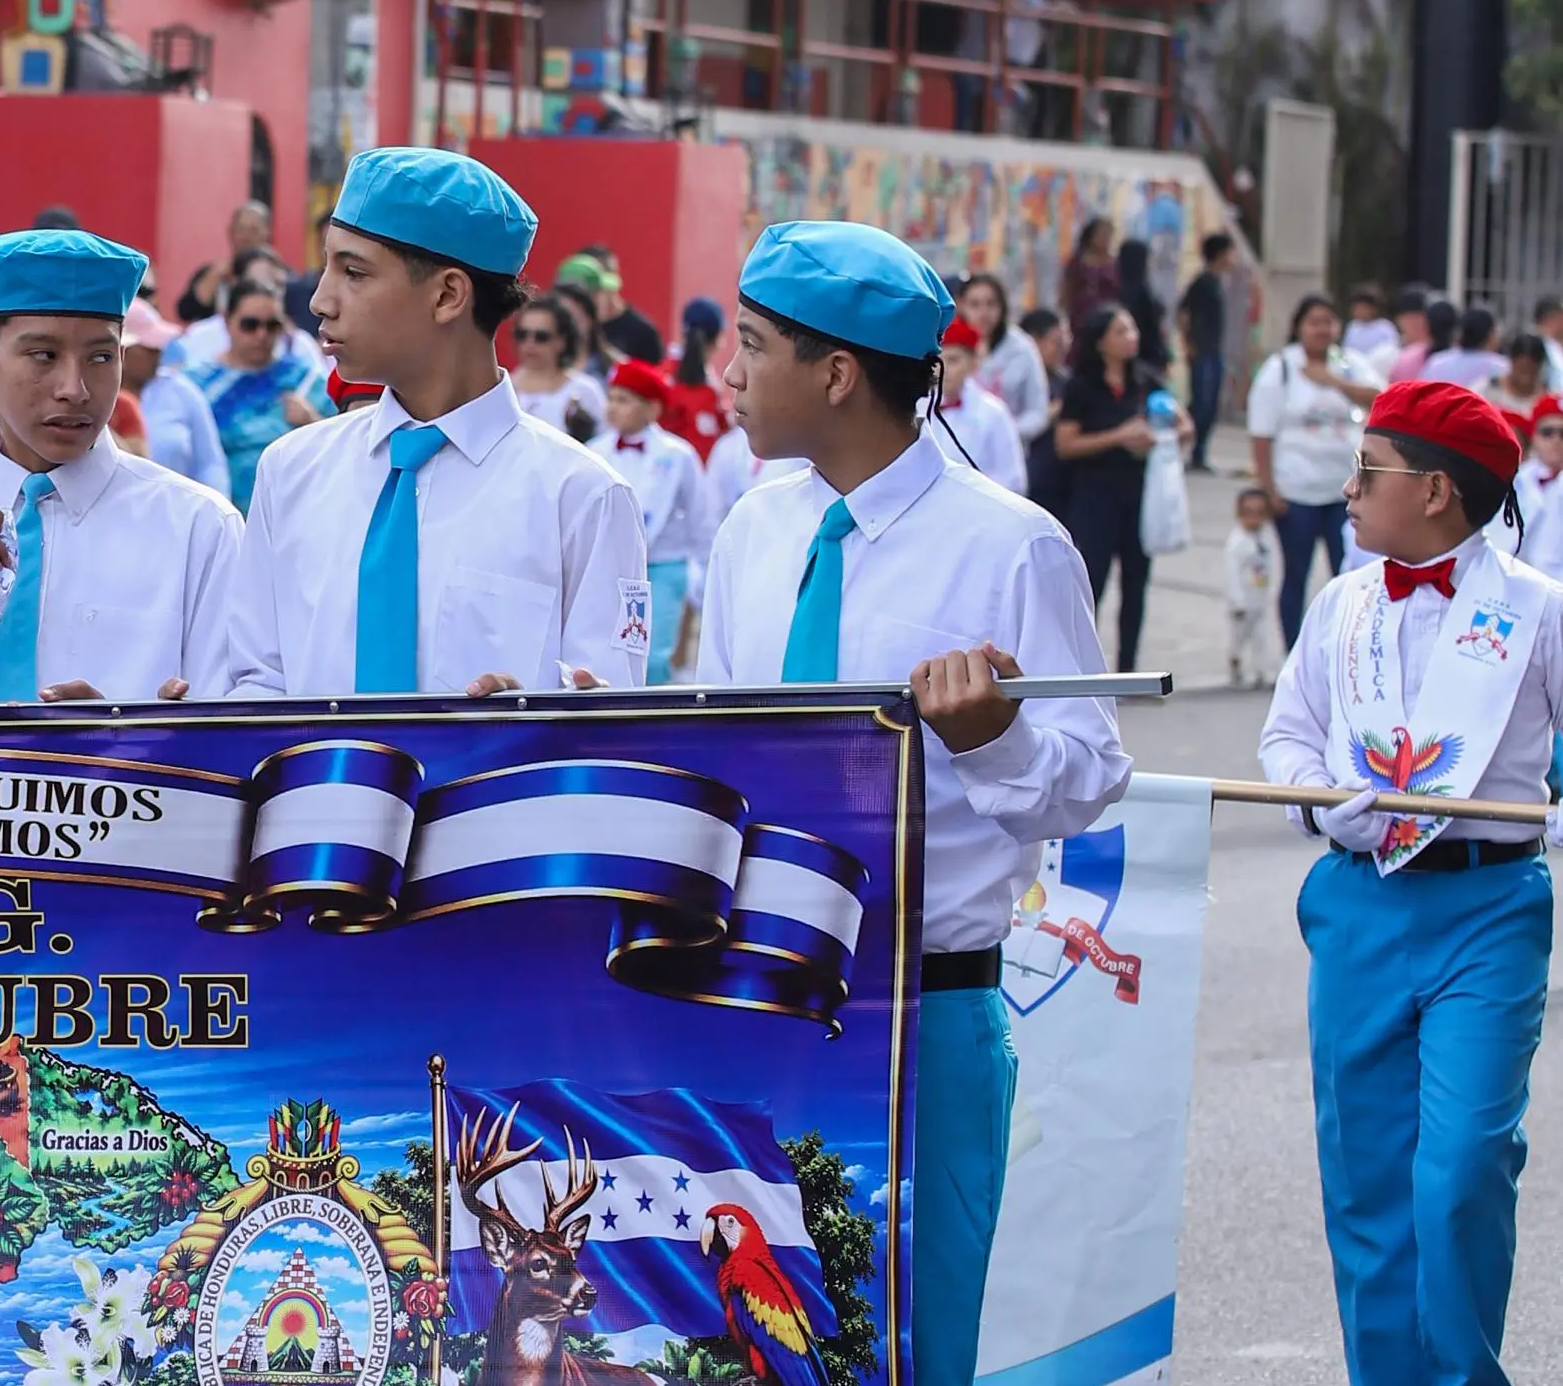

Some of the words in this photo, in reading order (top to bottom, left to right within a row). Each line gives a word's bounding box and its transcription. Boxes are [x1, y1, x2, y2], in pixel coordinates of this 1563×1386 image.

[1066, 925, 1083, 940] DE
[1084, 935, 1135, 975] OCTUBRE
[41, 1129, 108, 1151] Gracias
[112, 1135, 123, 1151] a
[128, 1130, 168, 1152] Dios
[264, 1198, 316, 1225] LIBRE,
[318, 1202, 378, 1281] SOBERANA
[203, 1217, 264, 1309] HONDURAS,
[371, 1284, 386, 1298] E
[198, 1311, 214, 1333] DE
